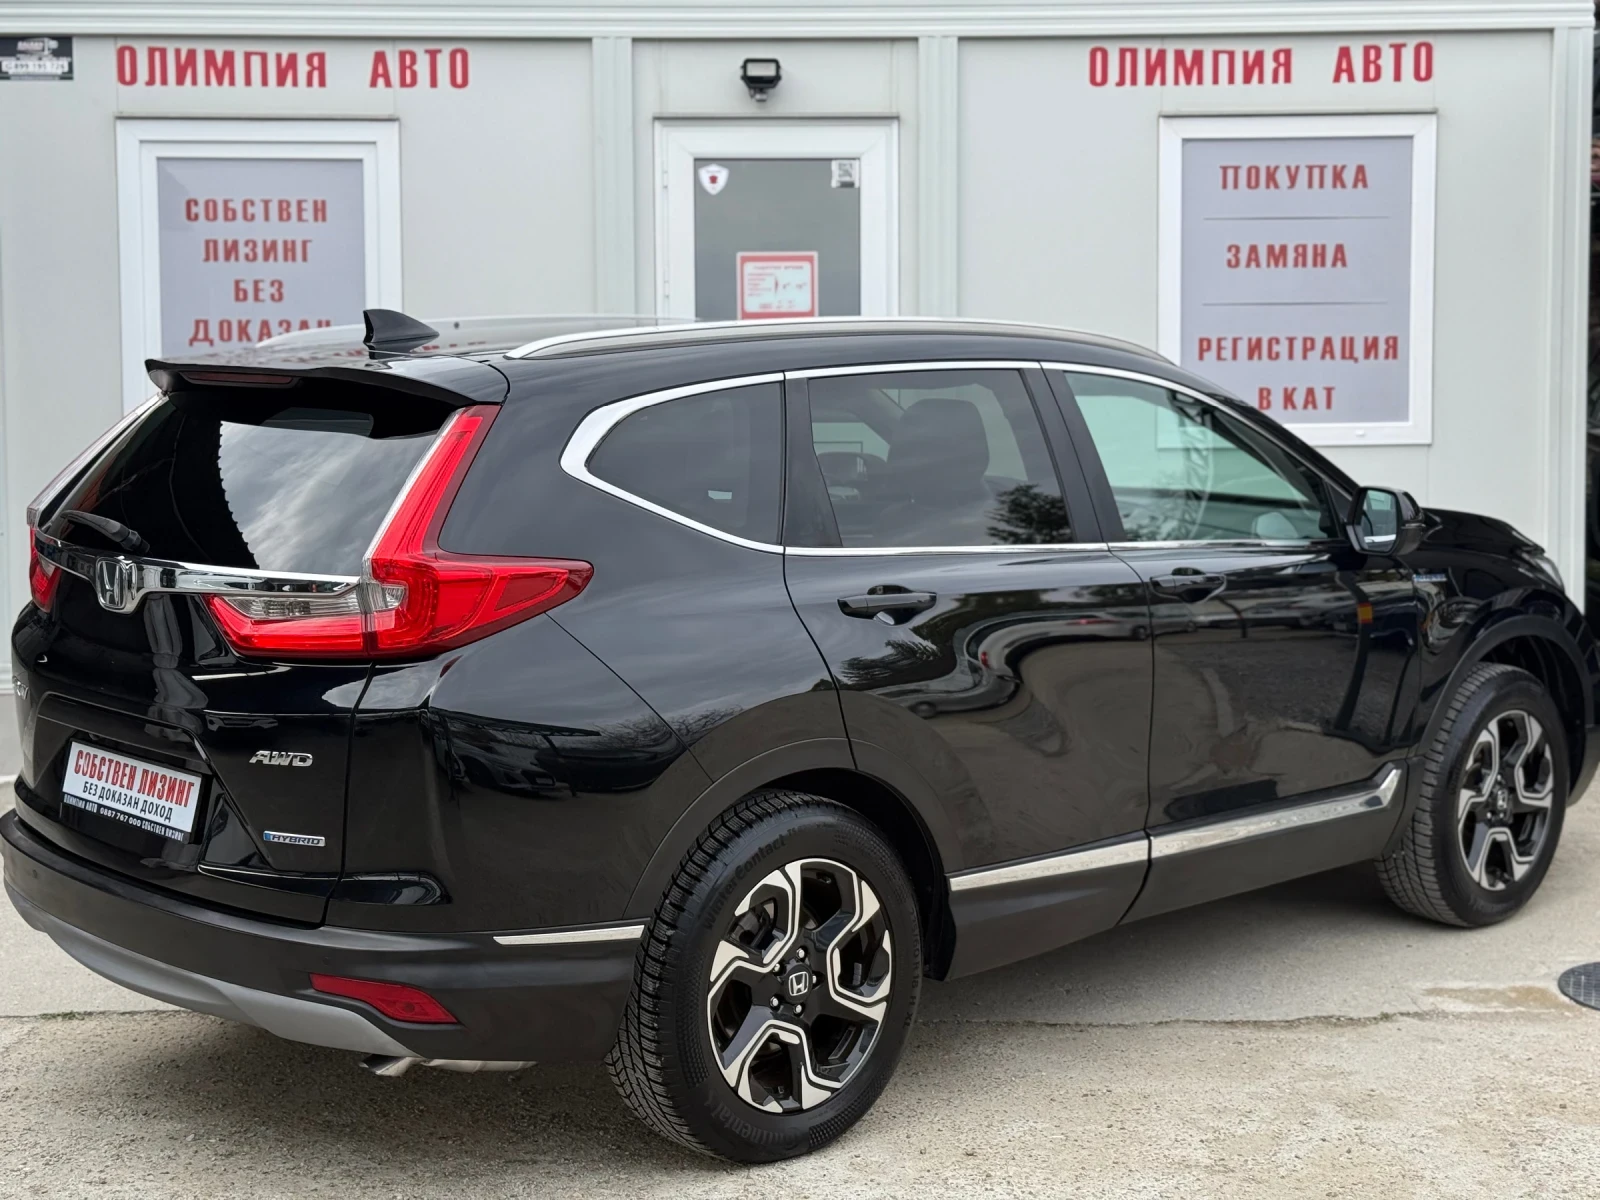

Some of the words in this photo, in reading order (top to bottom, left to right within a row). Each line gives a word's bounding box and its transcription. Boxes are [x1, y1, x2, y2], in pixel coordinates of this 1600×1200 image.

[116, 45, 327, 88] ОЛИМПИЯ
[369, 48, 470, 89] АВТО
[1088, 46, 1293, 87] ОЛИМПИЯ
[1332, 41, 1434, 84] АВТО
[1219, 164, 1369, 190] ПОКУПКА
[185, 198, 328, 223] СОБСТВЕН
[202, 238, 312, 263] ЛИЗИНГ
[1226, 244, 1348, 268] ЗАМЯНА
[233, 279, 284, 303] БЕЗ
[1197, 335, 1399, 364] РЕГИСТРАЦИЯ
[1258, 387, 1271, 411] В
[1282, 386, 1335, 411] КАТ
[249, 750, 314, 767] AWD
[74, 749, 137, 792] СОБСТВЕН
[137, 765, 195, 808] ЛИЗИНГ
[82, 780, 98, 797] БЕЗ
[98, 785, 140, 812] ДОКАЗАН
[140, 798, 174, 824] ДОХОД
[99, 807, 116, 818] 0887
[115, 812, 129, 823] 767
[128, 816, 141, 828] 000
[270, 833, 325, 846] HYBRID
